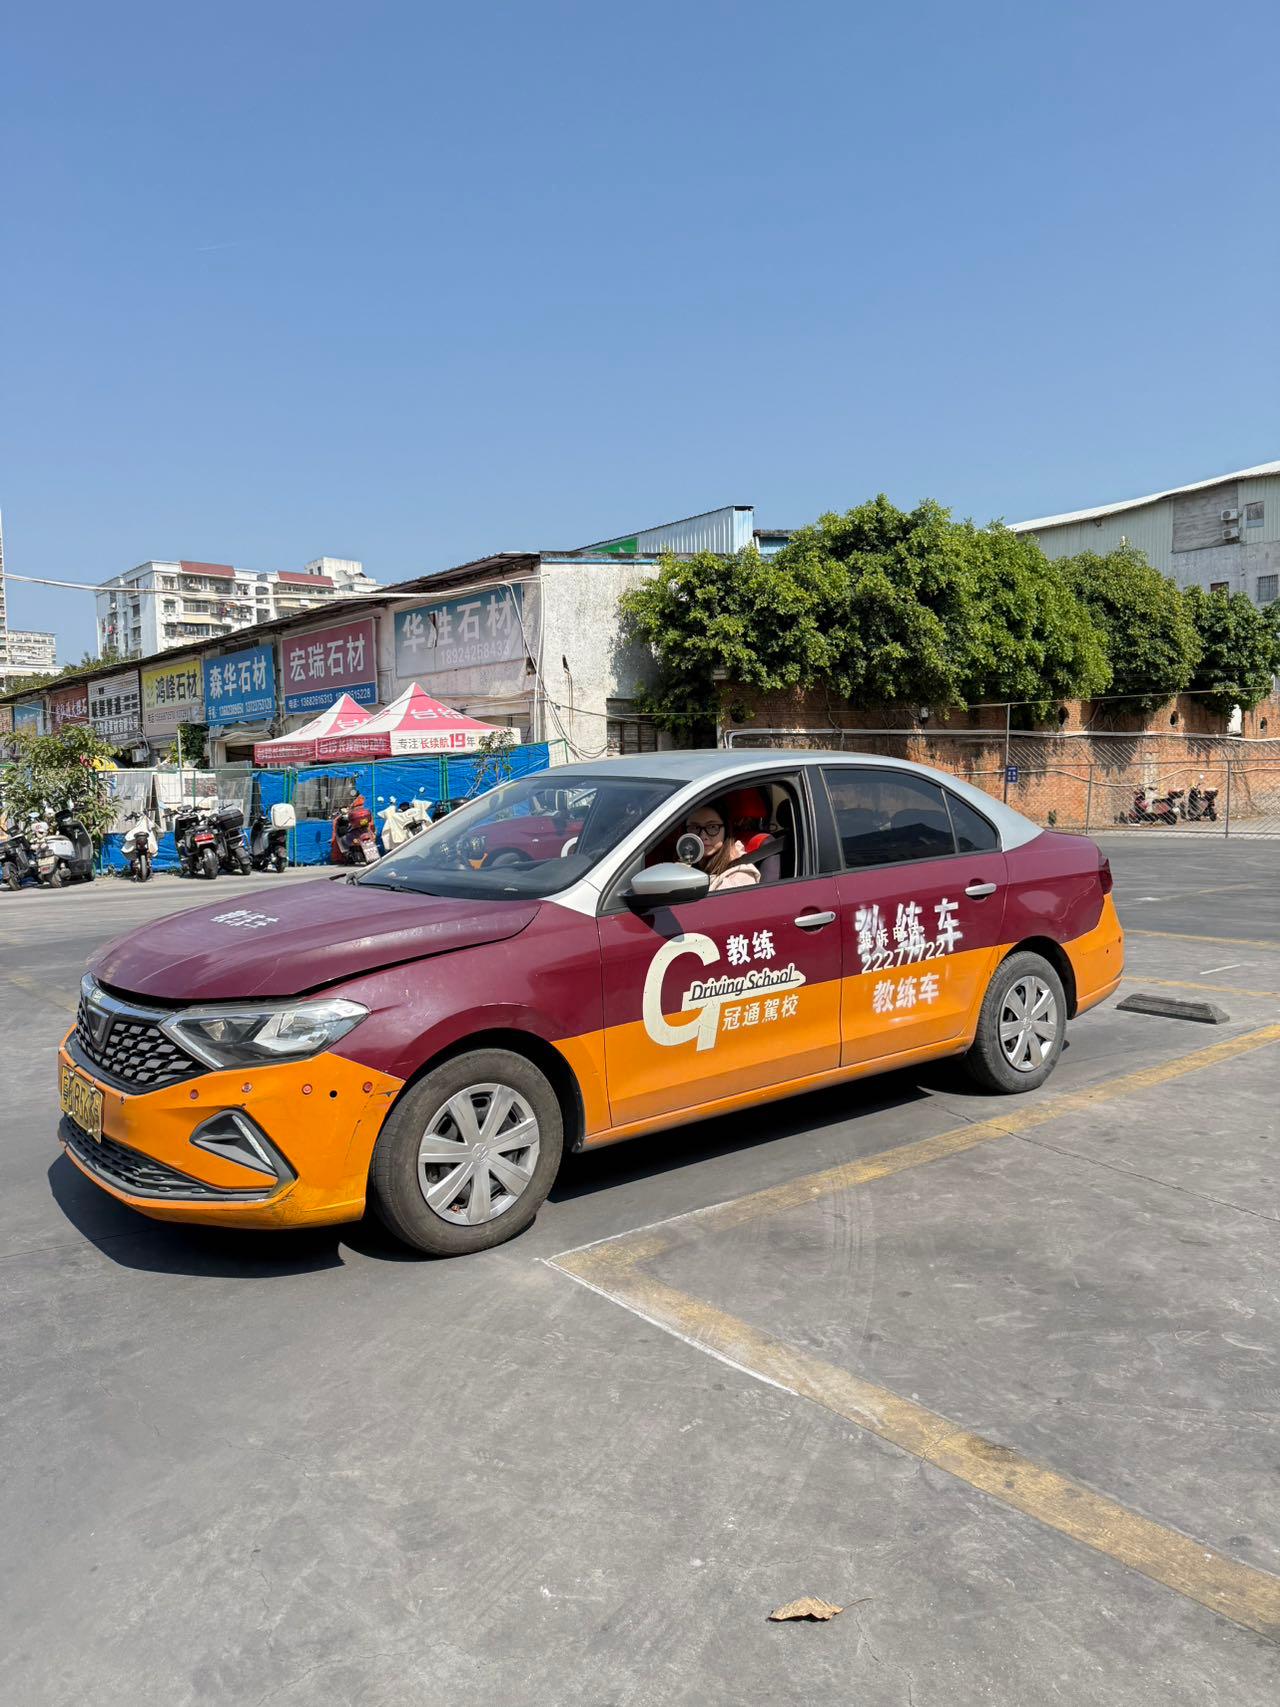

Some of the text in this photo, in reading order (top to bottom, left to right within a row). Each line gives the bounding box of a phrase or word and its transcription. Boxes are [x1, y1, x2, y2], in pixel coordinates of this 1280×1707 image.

[289, 633, 365, 681] 宏瑞石材
[209, 655, 266, 699] 森华石材
[726, 930, 776, 966] 教练
[861, 941, 946, 975] 22277722
[691, 966, 795, 1001] Driving School
[872, 973, 940, 1014] 教练车
[722, 995, 800, 1031] 冠通駕校
